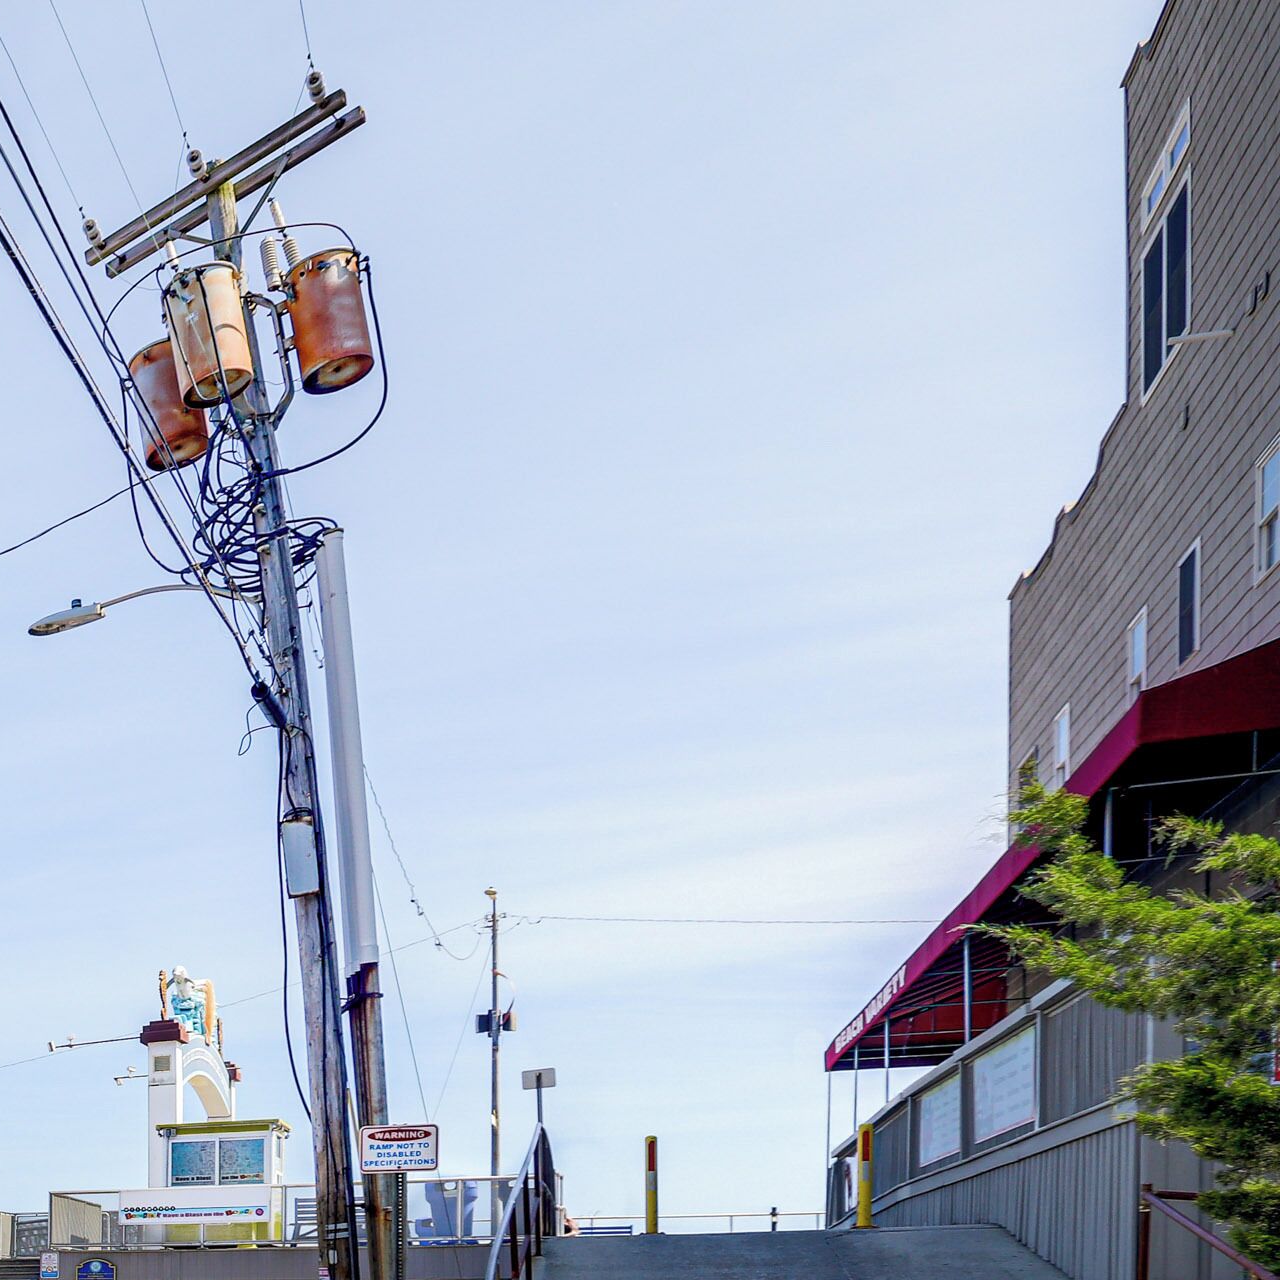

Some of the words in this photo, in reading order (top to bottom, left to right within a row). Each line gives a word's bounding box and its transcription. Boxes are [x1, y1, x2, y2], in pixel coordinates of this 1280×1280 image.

[835, 1013, 864, 1053] BEACH
[864, 964, 907, 1024] VARIETY
[374, 1130, 425, 1140] WARNING
[376, 1150, 422, 1158] DISABLED
[364, 1158, 436, 1167] SPECIFICATIONS
